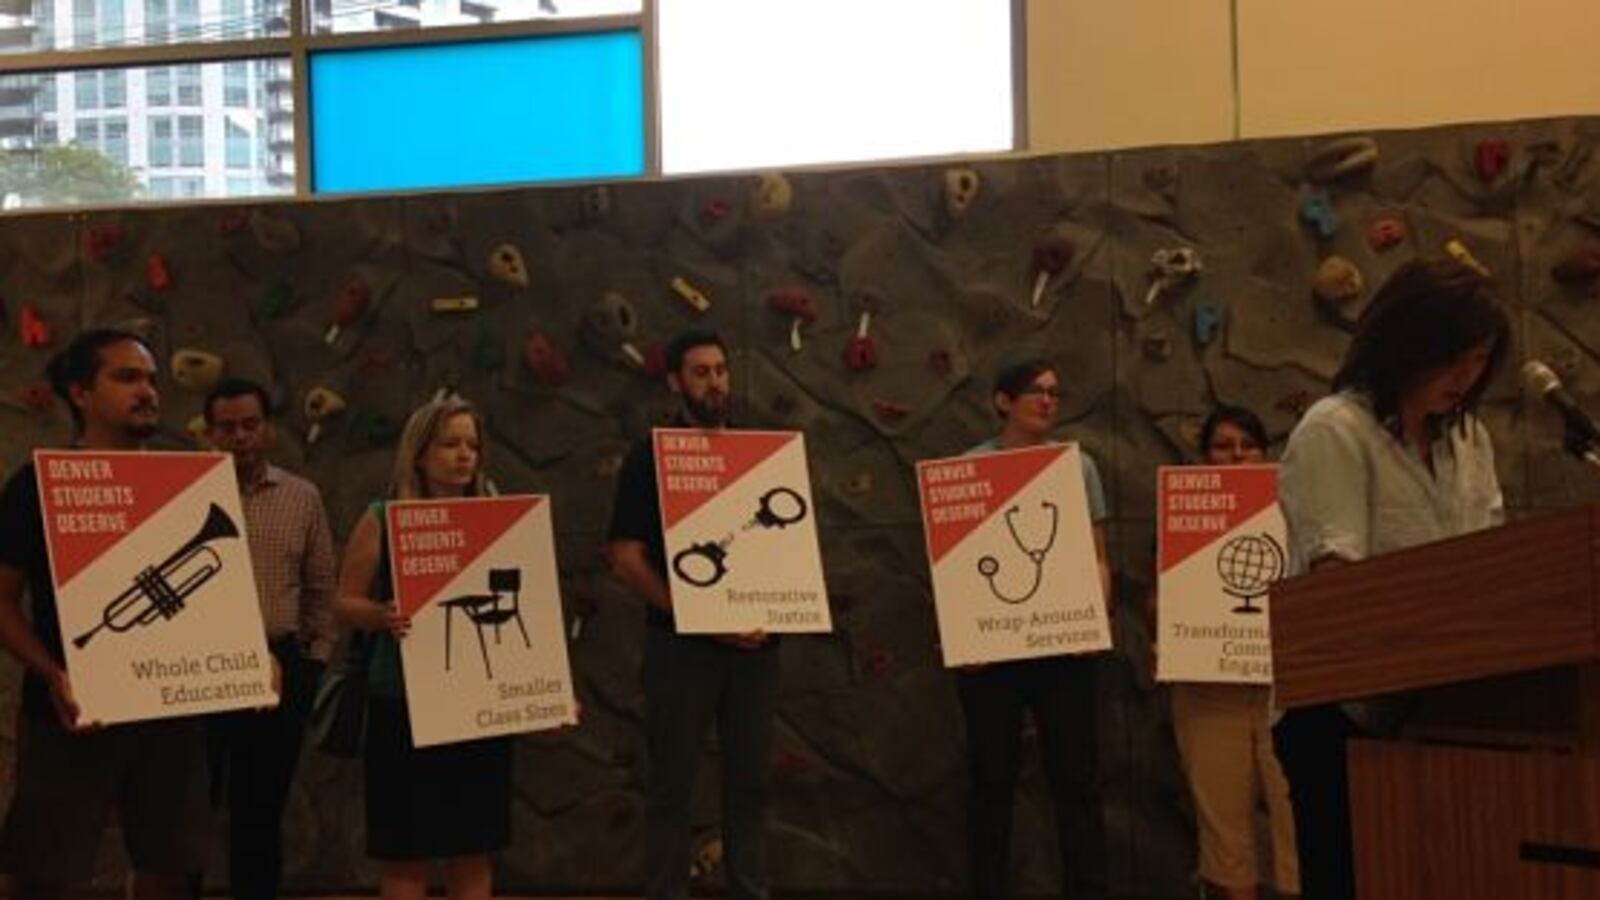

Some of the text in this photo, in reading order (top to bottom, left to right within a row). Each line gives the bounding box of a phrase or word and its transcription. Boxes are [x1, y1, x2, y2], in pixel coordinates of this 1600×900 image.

[131, 651, 260, 680] Whole Child
[161, 682, 264, 705] Education
